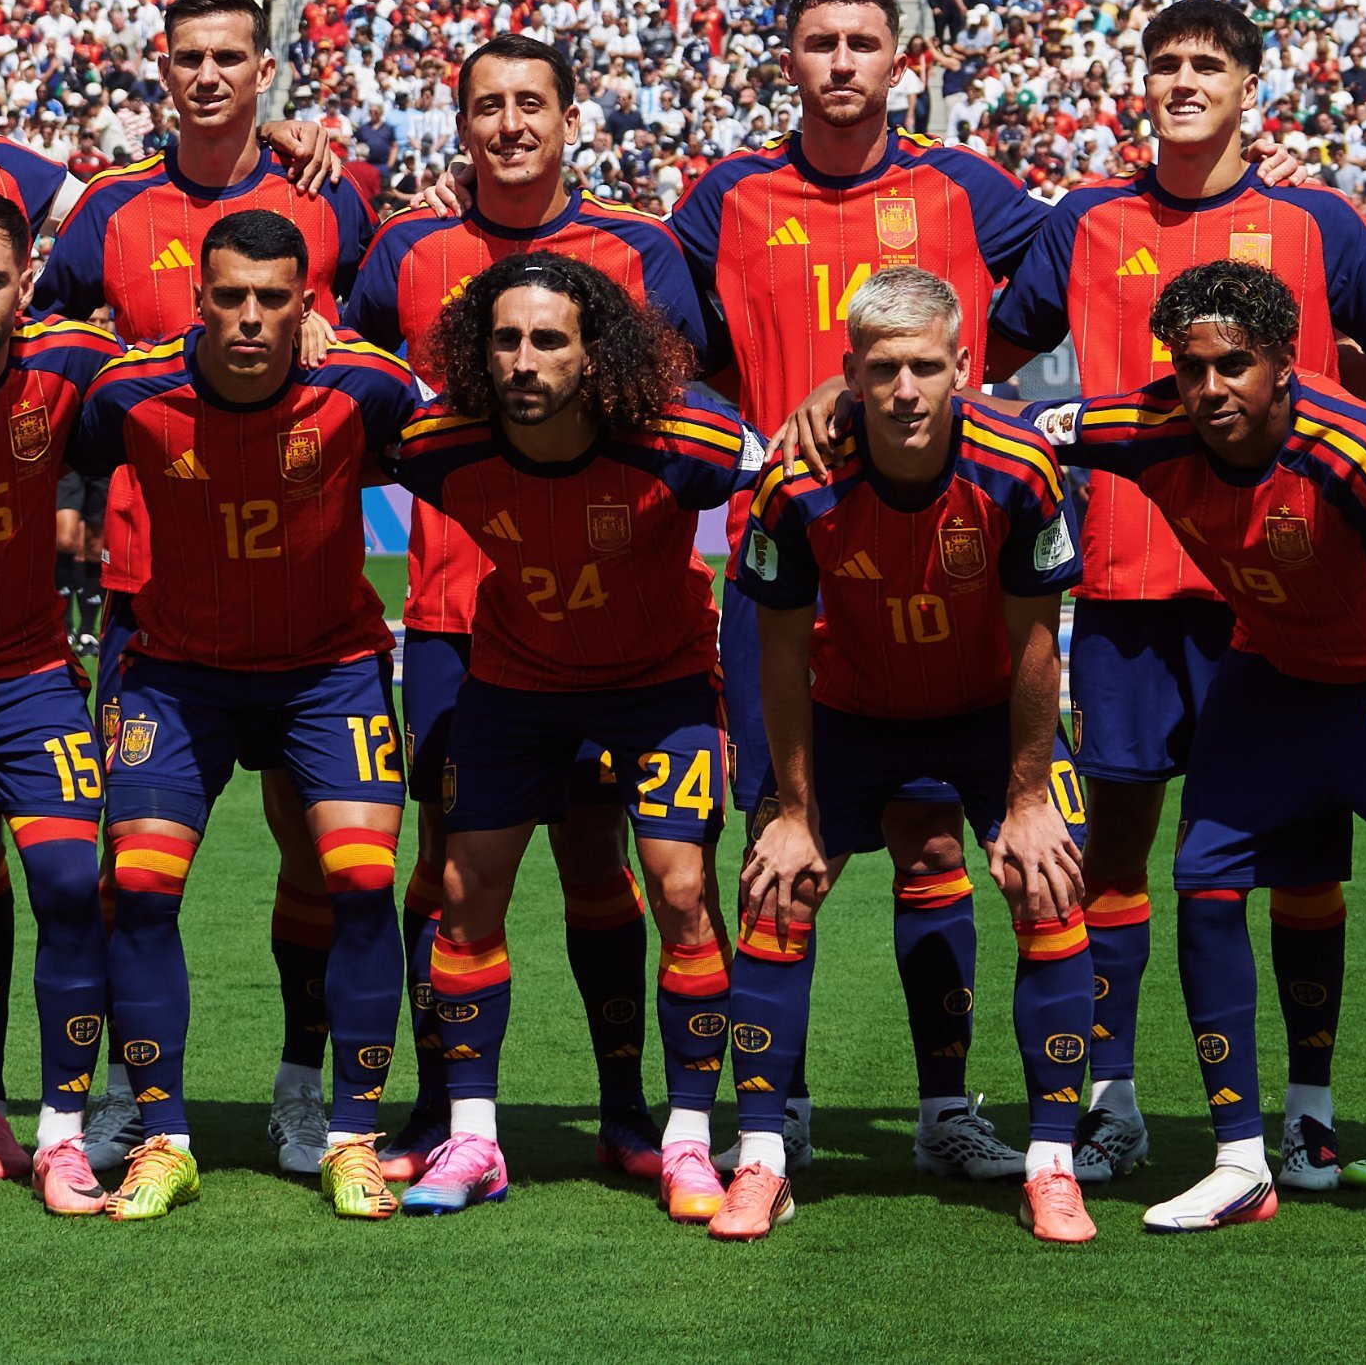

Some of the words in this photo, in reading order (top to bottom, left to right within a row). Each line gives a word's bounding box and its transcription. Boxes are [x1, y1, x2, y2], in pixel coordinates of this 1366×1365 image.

[813, 262, 873, 331] 14
[219, 499, 282, 560] 12
[521, 563, 609, 622] 24
[1221, 557, 1288, 605] 19
[886, 593, 951, 644] 10
[43, 731, 102, 803] 15
[346, 714, 402, 783] 12
[637, 748, 715, 820] 24
[1050, 760, 1087, 825] 0
[76, 1022, 95, 1030] RF
[76, 1030, 94, 1039] EF
[1055, 1039, 1076, 1048] RF
[1202, 1039, 1219, 1048] RF
[1054, 1048, 1075, 1057] EF
[1203, 1047, 1220, 1057] EF
